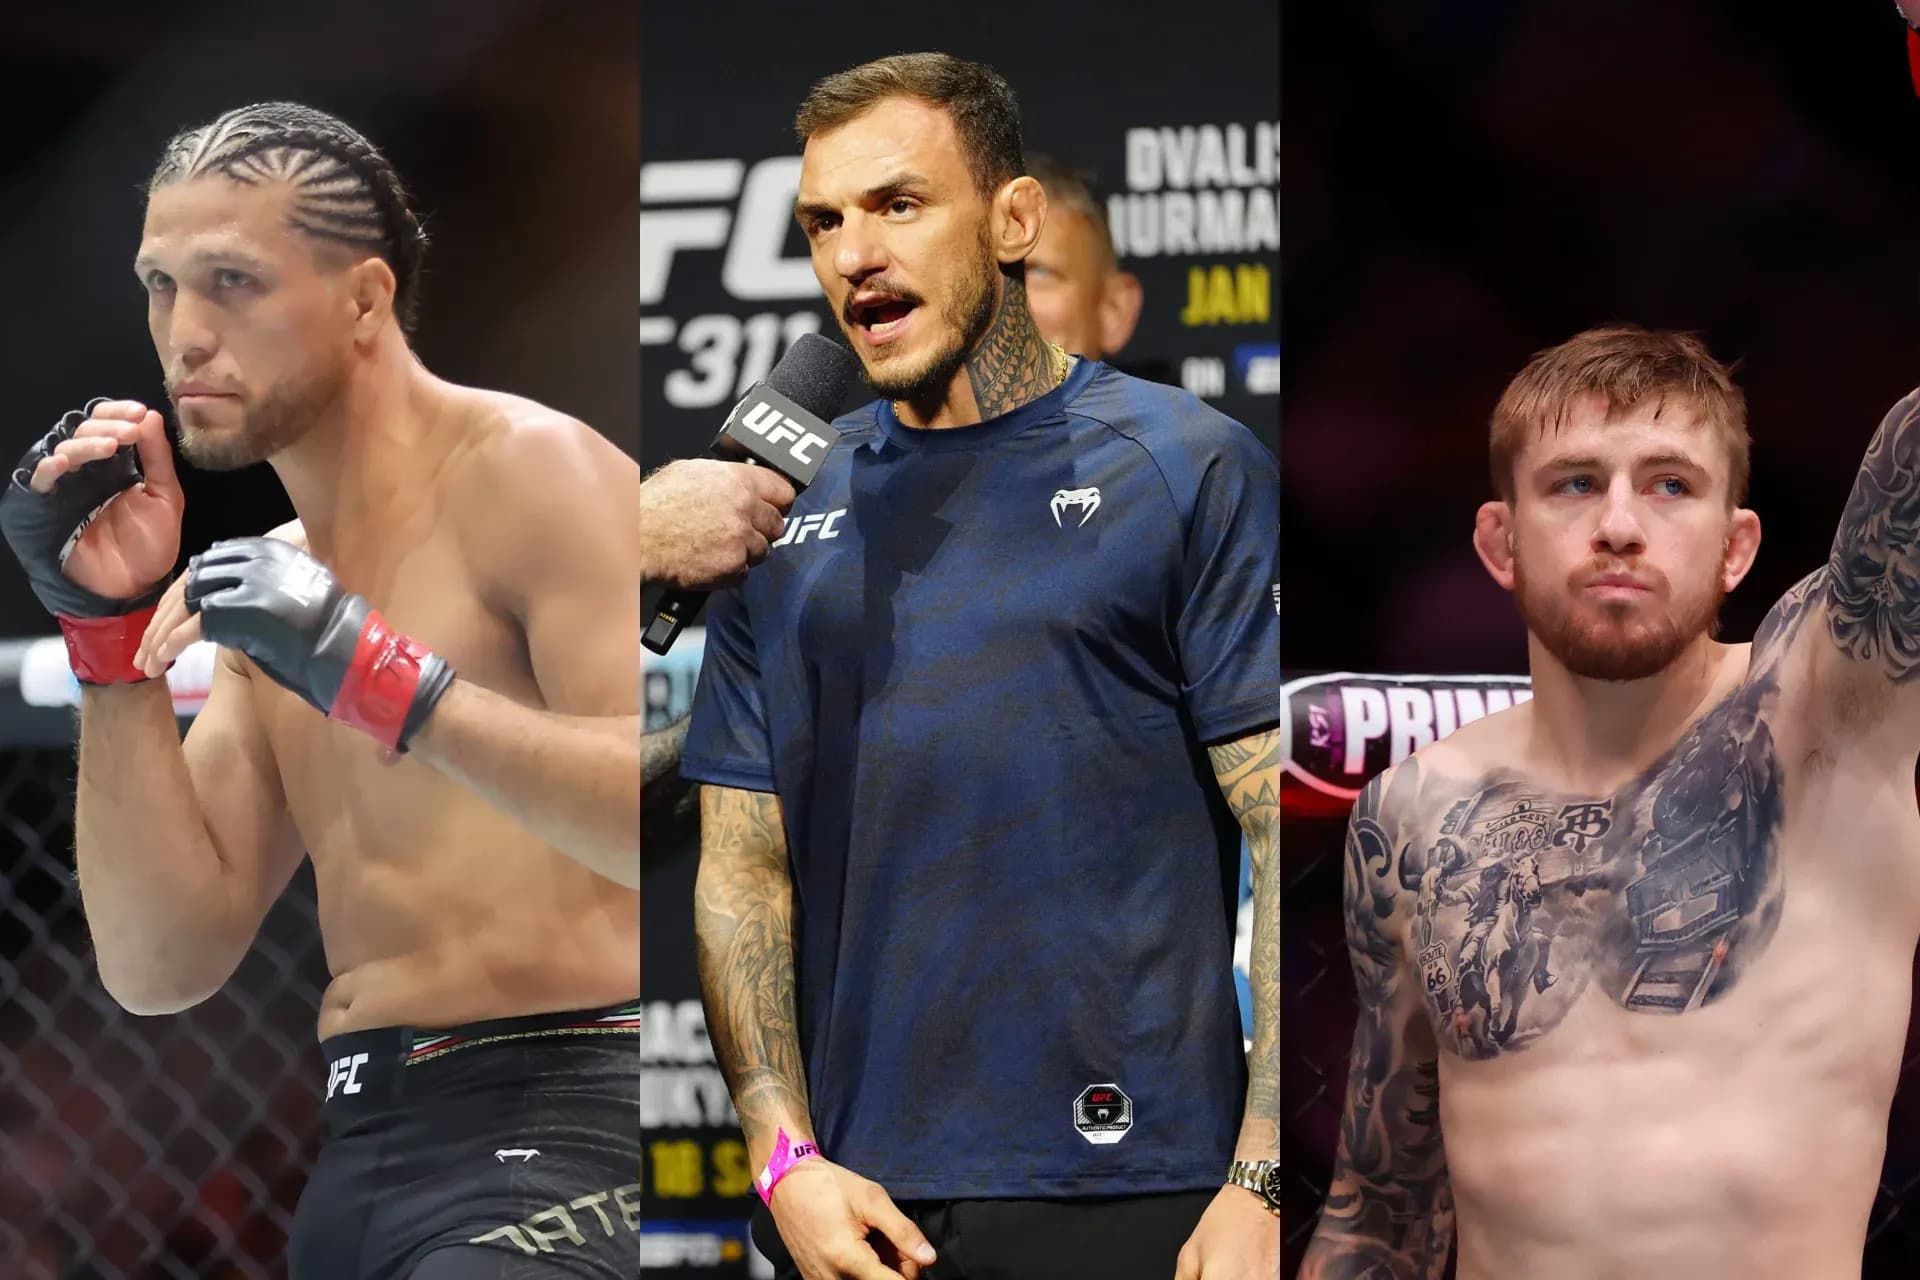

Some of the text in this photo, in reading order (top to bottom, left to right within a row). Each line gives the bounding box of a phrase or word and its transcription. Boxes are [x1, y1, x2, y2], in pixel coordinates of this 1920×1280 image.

[1125, 121, 1280, 191] DVALI
[1181, 264, 1270, 325] JAN
[742, 401, 829, 465] UFC
[772, 508, 848, 549] UFC
[1309, 703, 1330, 748] KSI
[1420, 947, 1443, 962] ROUTE
[1427, 967, 1446, 990] 66
[1092, 1092, 1113, 1103] UFC
